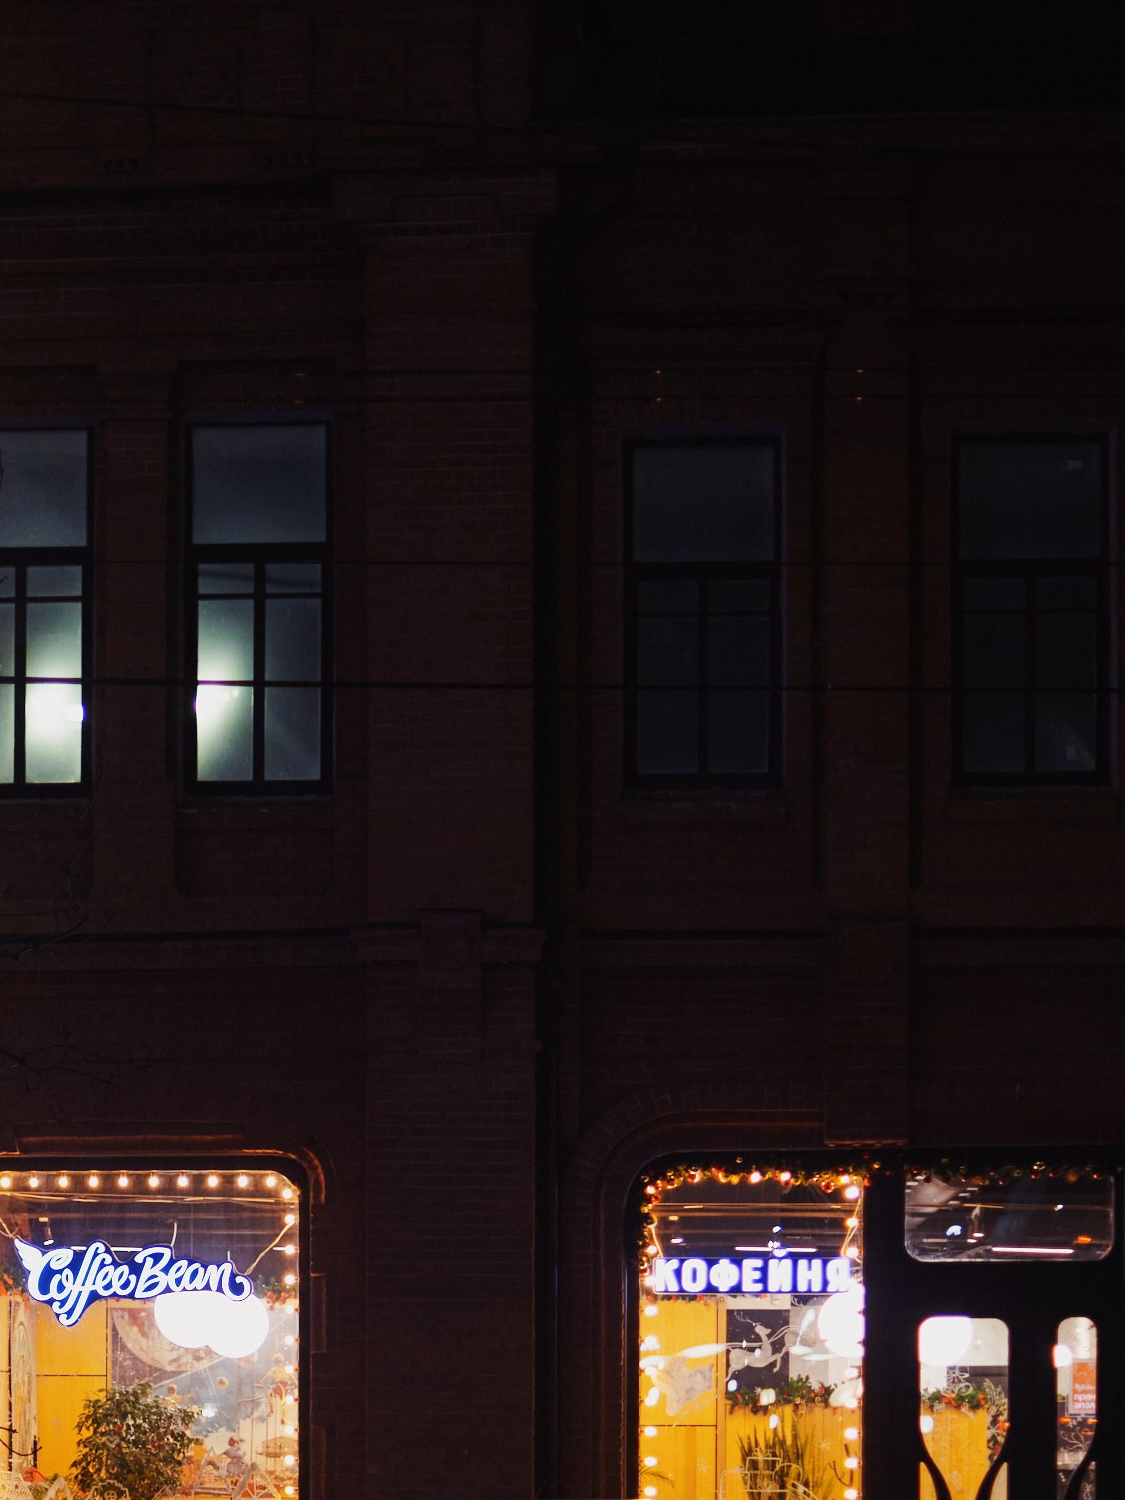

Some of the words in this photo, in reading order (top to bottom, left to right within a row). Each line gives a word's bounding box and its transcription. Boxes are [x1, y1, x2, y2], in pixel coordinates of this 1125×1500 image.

[25, 1240, 137, 1327] Coffee
[133, 1245, 253, 1302] Bean
[654, 1251, 851, 1293] КОФЕЙНЯ
